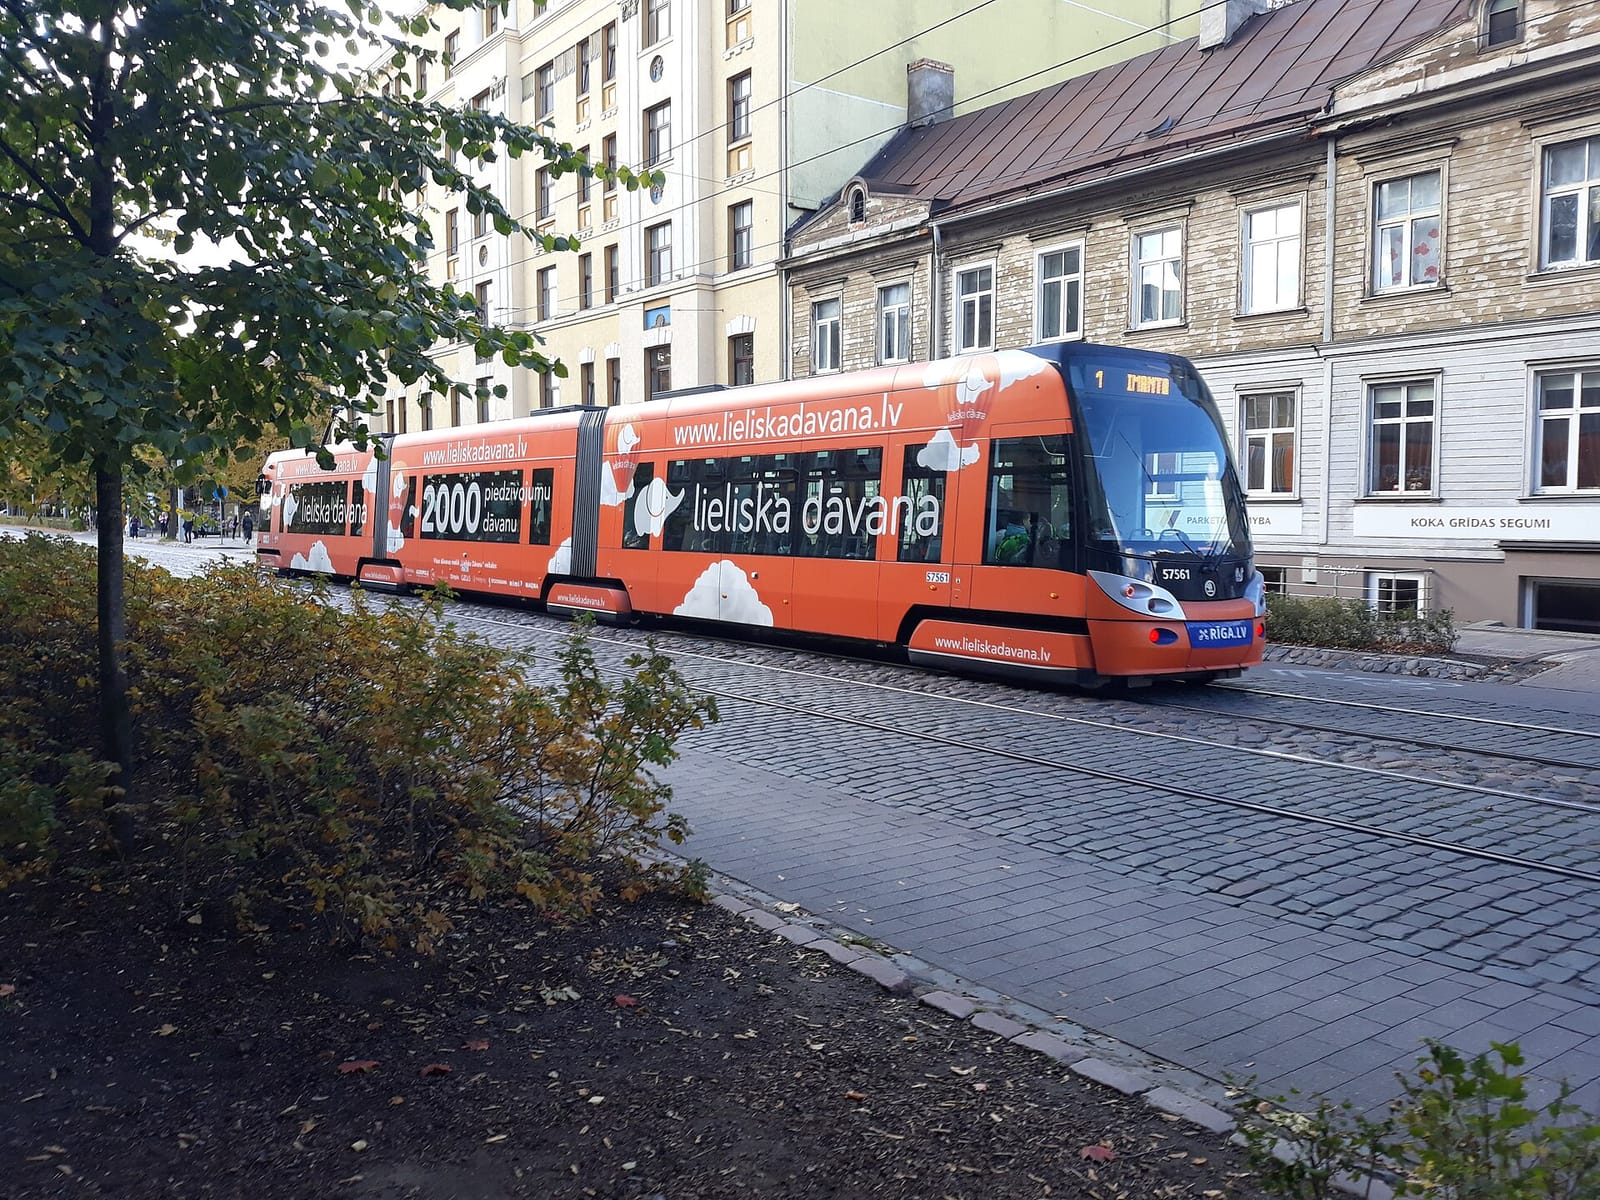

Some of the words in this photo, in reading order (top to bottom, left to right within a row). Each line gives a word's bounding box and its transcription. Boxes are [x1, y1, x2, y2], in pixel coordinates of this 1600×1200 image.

[1095, 370, 1104, 389] 1
[1127, 373, 1169, 396] IMANTA
[674, 392, 904, 446] www.lieliskadavana.lv
[423, 434, 528, 465] www.lieliskadavana.lv
[484, 480, 551, 508] piedzīvojumu
[301, 495, 330, 523] lieliska
[332, 495, 368, 525] dāvana
[693, 480, 791, 533] lieliska
[801, 478, 940, 537] dāvana
[483, 512, 518, 533] dāvanu
[1410, 518, 1445, 527] KOKA
[1449, 517, 1496, 528] GRĪDAS
[1500, 518, 1550, 529] SEGUMI
[926, 572, 949, 583] 57561
[1162, 568, 1190, 580] 57561
[1211, 625, 1247, 640] RĪGA.LV
[934, 636, 1051, 662] www.lieliskadavana.lv
